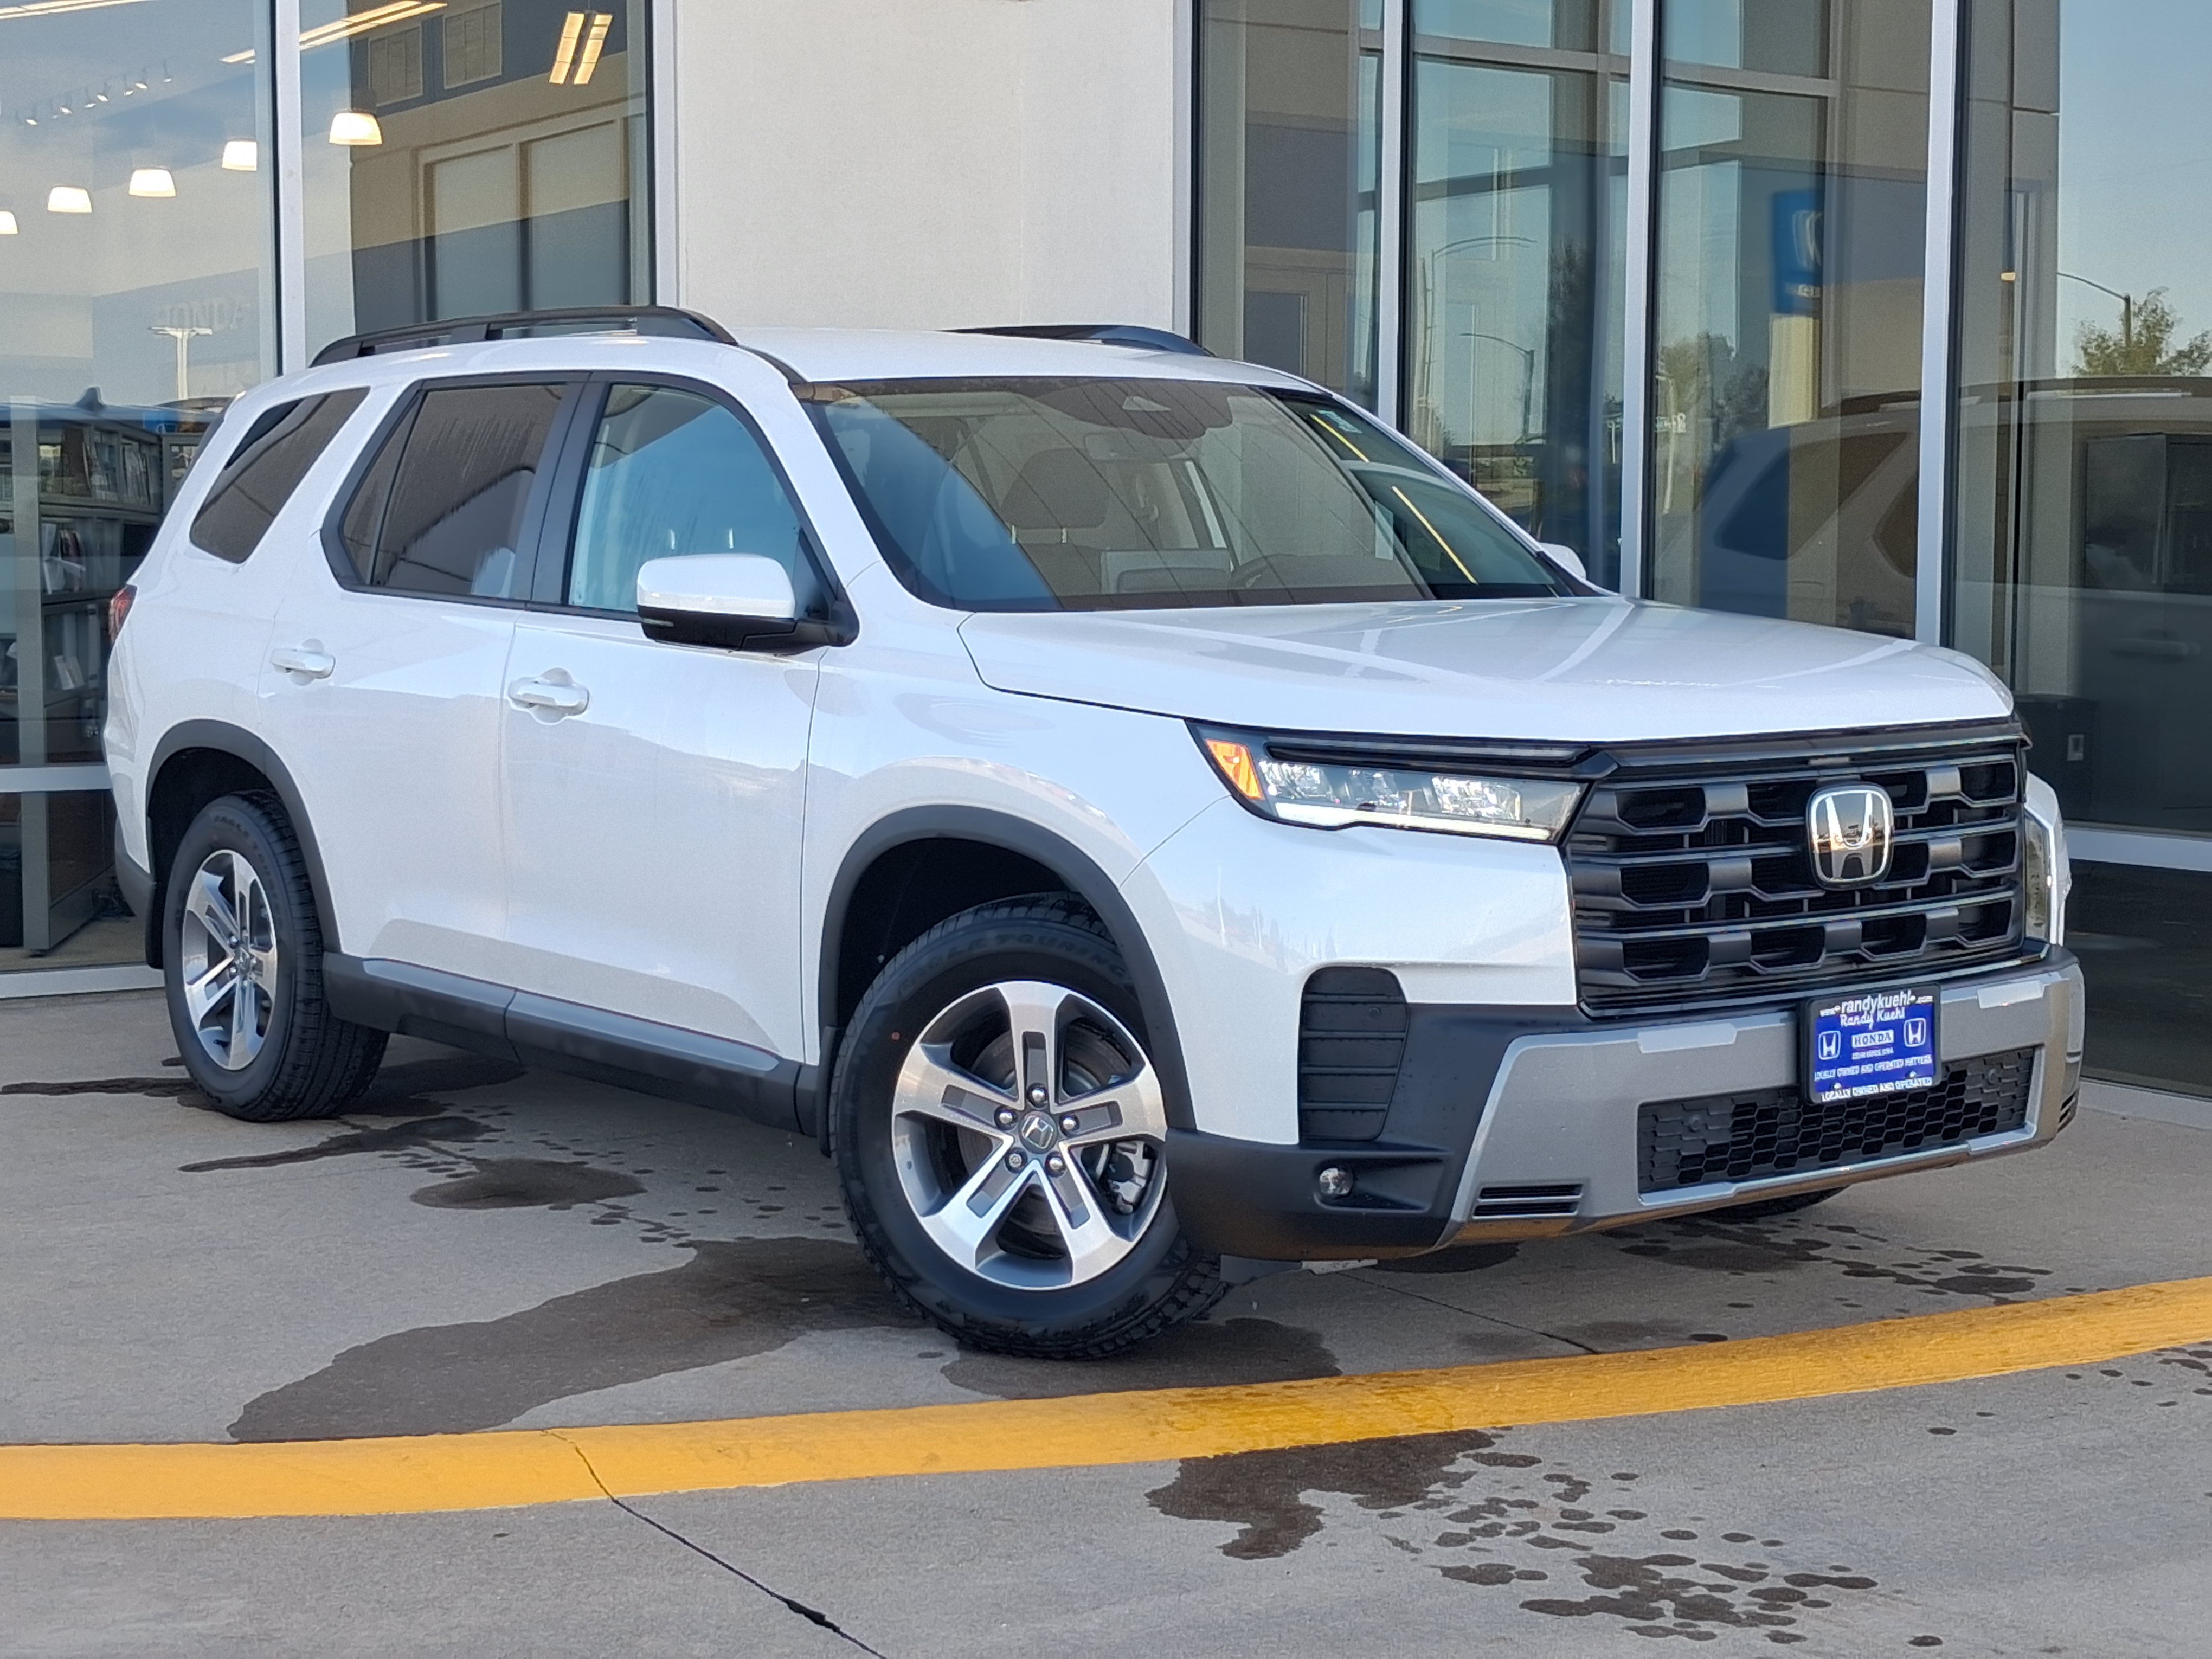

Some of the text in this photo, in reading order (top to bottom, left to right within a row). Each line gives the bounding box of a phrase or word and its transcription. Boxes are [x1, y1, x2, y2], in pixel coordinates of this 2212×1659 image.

[1840, 1012, 1874, 1030] Randy
[1877, 1007, 1906, 1022] Kuehl
[1854, 1032, 1892, 1046] HONDA
[1821, 1087, 1851, 1102] LOCALLY
[1879, 1081, 1895, 1091] AND
[1895, 1077, 1933, 1090] OPERATED
